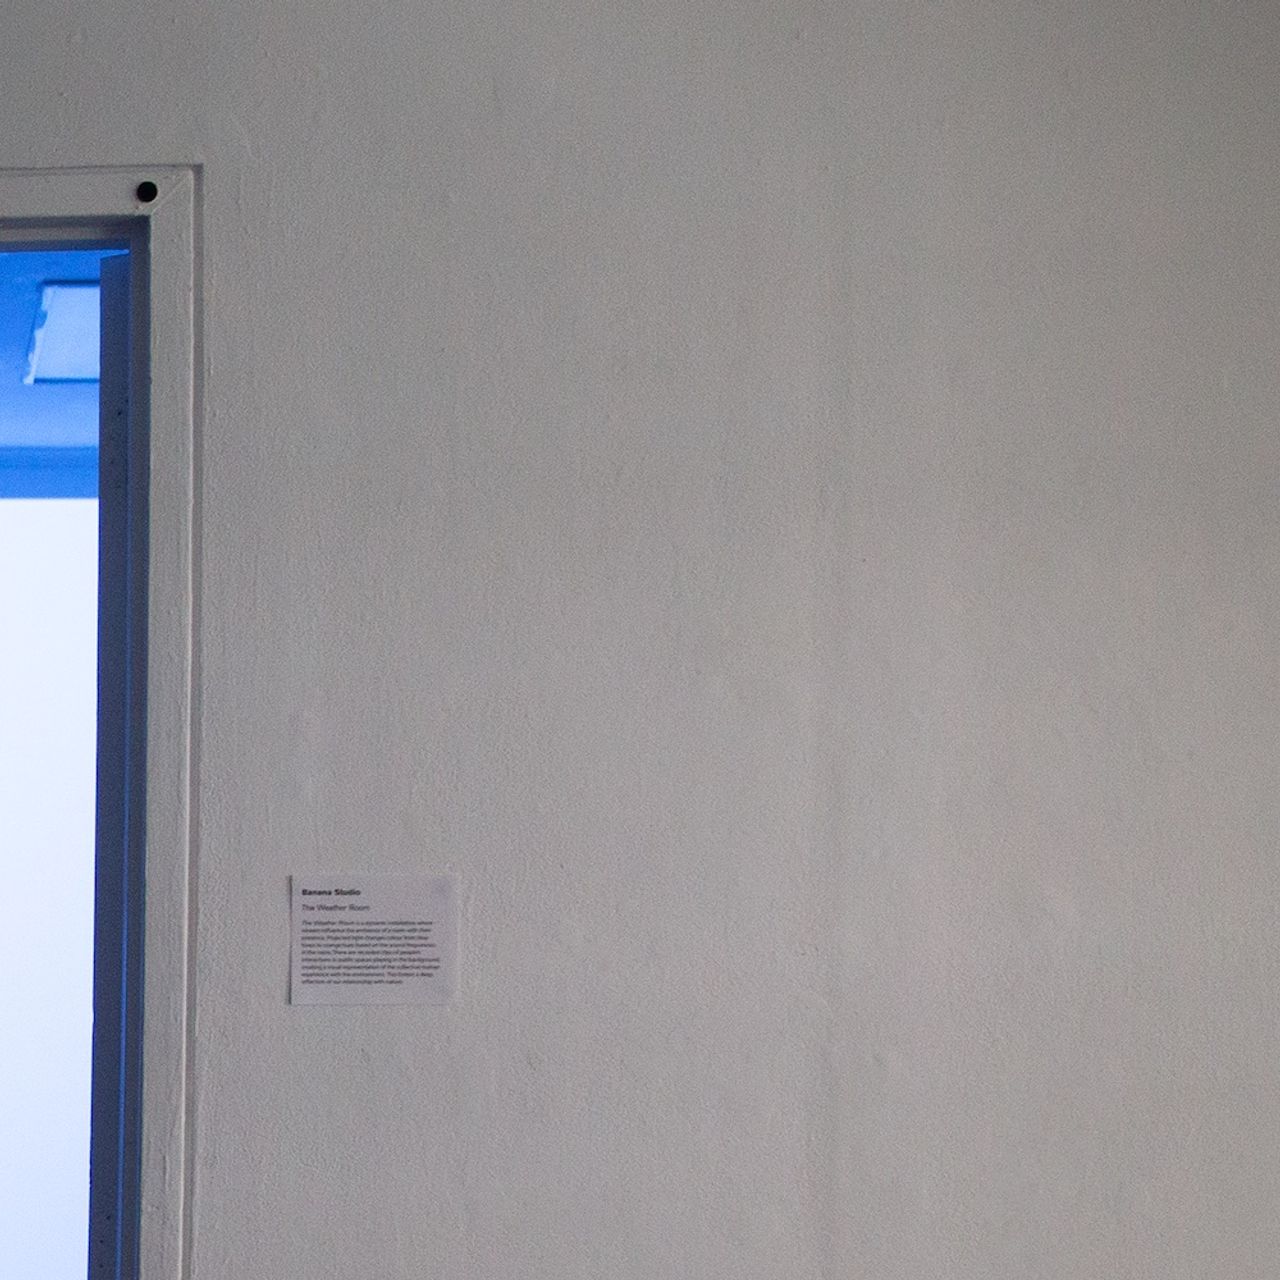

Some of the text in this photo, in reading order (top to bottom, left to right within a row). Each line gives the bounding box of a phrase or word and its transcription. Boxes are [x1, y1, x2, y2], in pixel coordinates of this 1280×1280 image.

[302, 903, 371, 911] The Weather Room
